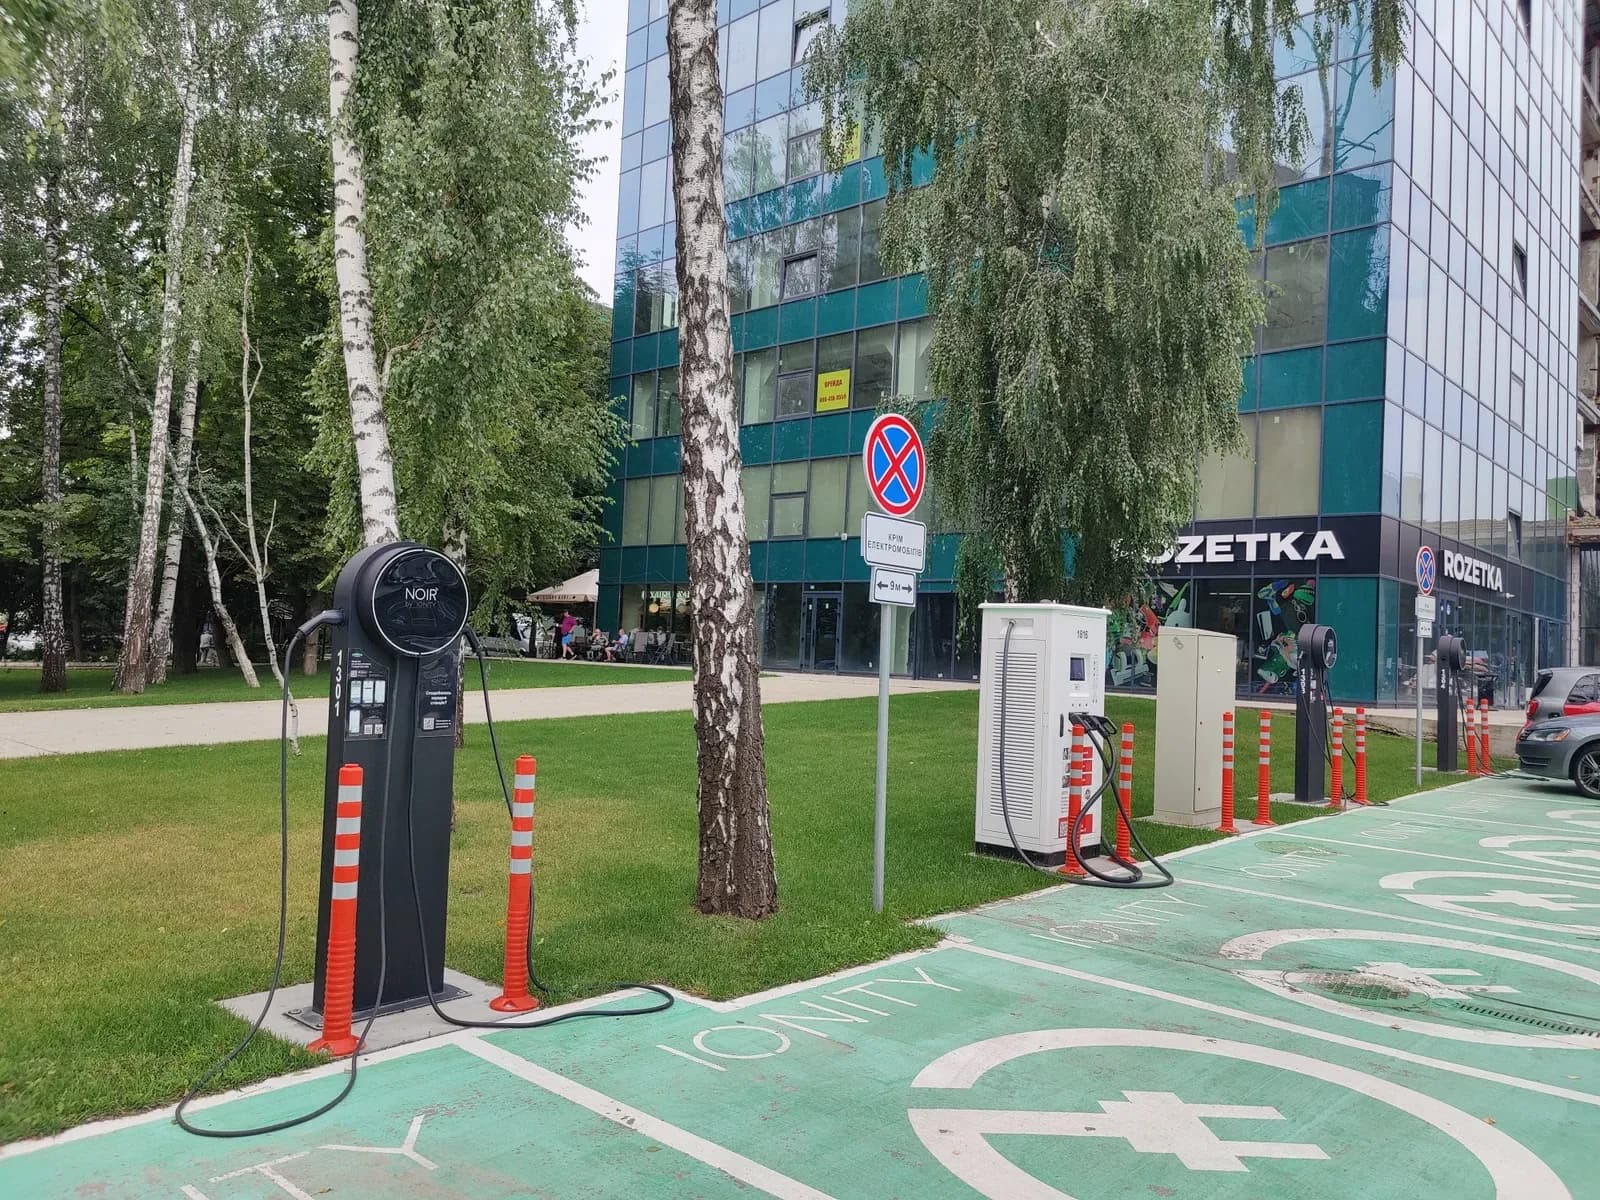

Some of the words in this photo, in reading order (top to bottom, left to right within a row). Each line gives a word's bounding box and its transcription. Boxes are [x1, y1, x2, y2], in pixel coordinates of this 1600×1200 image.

[888, 533, 904, 543] КРІМ
[1112, 530, 1345, 565] OZETKA
[1443, 549, 1503, 593] ROZETKA
[405, 587, 437, 601] NOIR
[334, 649, 343, 717] 1301
[656, 967, 962, 1072] IONITY
